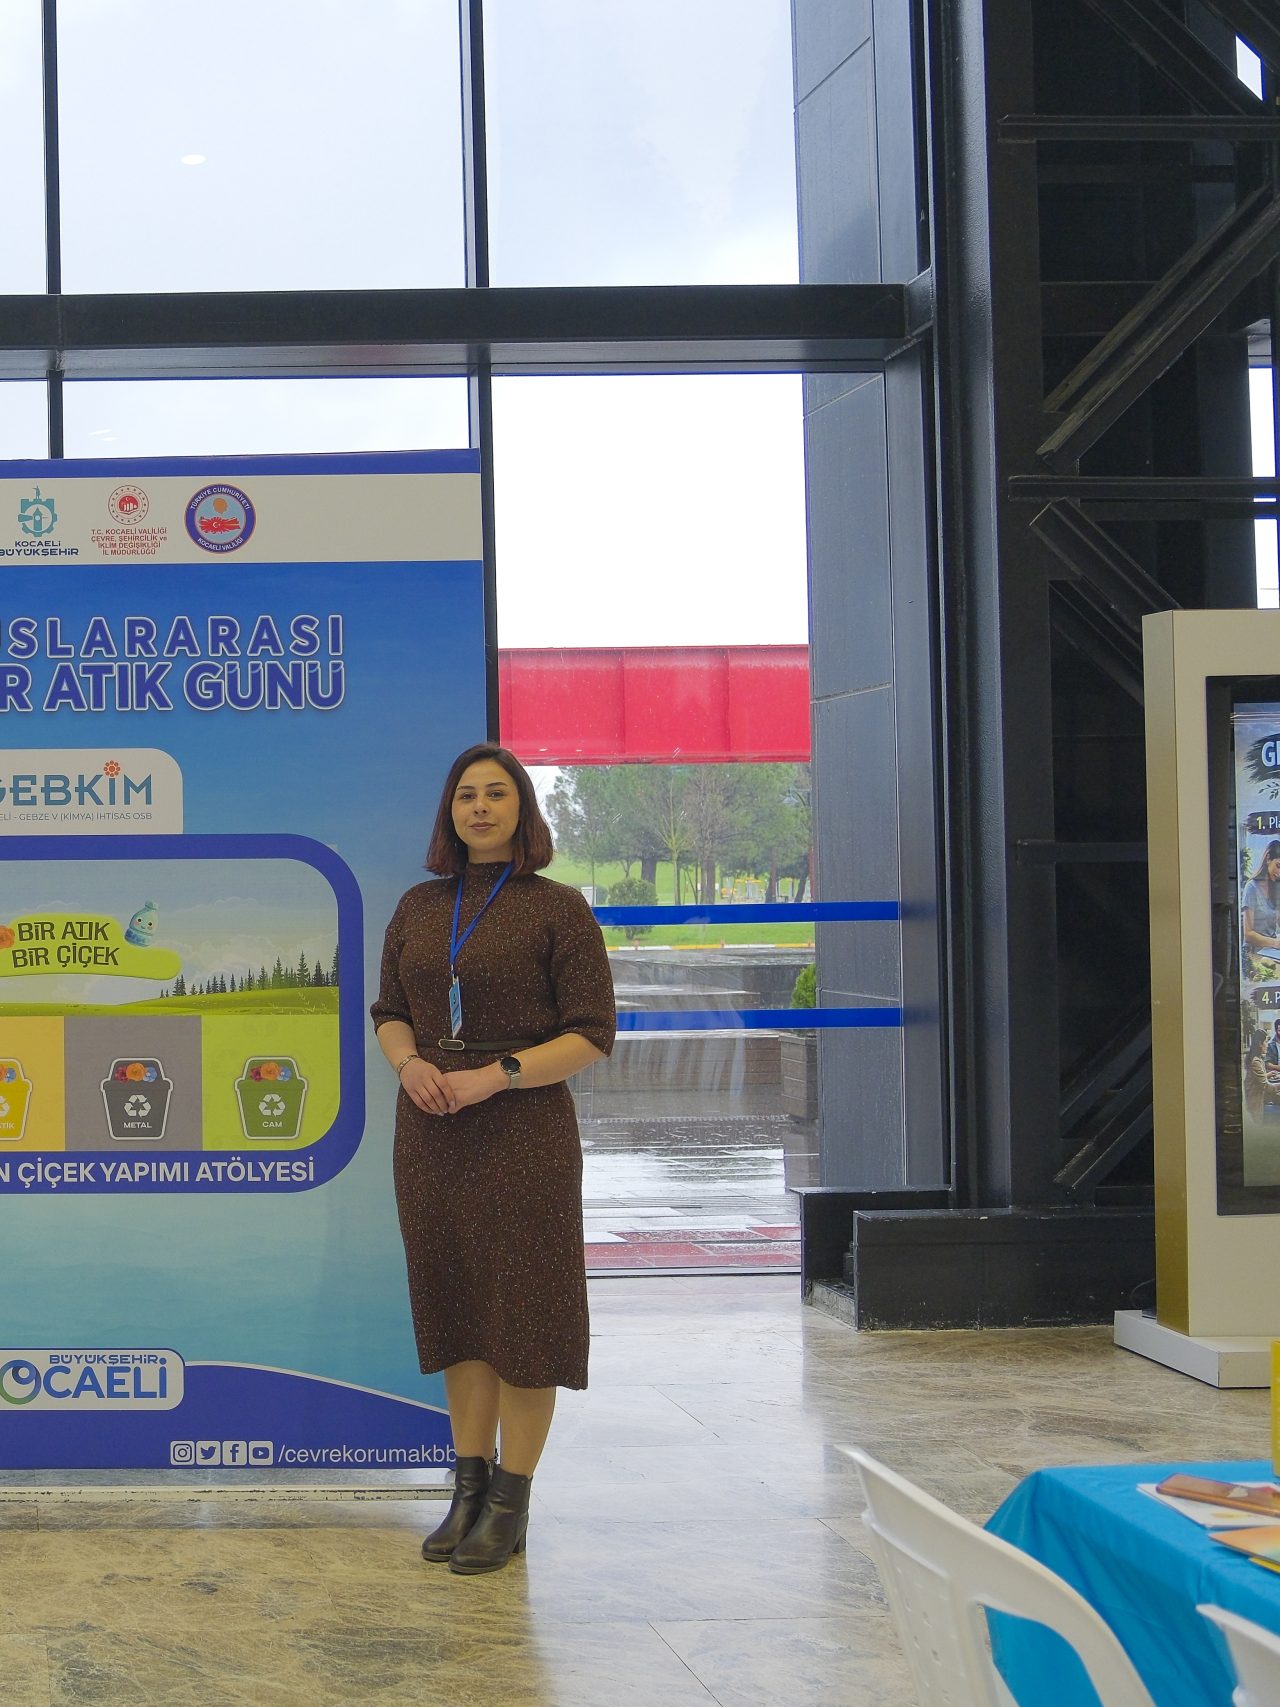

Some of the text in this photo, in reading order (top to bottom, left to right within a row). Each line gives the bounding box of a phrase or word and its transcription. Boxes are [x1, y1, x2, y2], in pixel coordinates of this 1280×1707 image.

[190, 488, 212, 510] TÜRKİYE
[105, 527, 137, 535] KOCAELİ
[138, 526, 167, 535] VALİLİĞİ
[91, 535, 117, 543] ÇEVRE,
[118, 534, 158, 543] ŞEHİRCİLİK
[97, 540, 161, 550] İKLİM DEĞİŞİKLİĞİ
[197, 537, 222, 551] KOCAELİ
[110, 547, 156, 556] MÜDÜRLÜĞÜ
[42, 660, 173, 713] ATIK
[183, 659, 345, 711] GÜNÜ
[19, 812, 50, 821] GEBZE
[51, 812, 59, 821] V
[60, 811, 95, 822] (KİMYA)
[96, 810, 131, 821] İHTİSAS
[133, 811, 152, 820] OSB
[1256, 816, 1266, 830] 1.
[17, 921, 110, 942] BİR ATIK
[12, 942, 120, 968] BİR ÇİÇEK
[1261, 991, 1273, 1005] 4.
[123, 1121, 153, 1129] METAL
[262, 1120, 283, 1129] CAM
[17, 1157, 96, 1189] ÇİÇEK
[99, 1161, 189, 1183] YAPIMI
[195, 1156, 315, 1183] ATÖLYESİ
